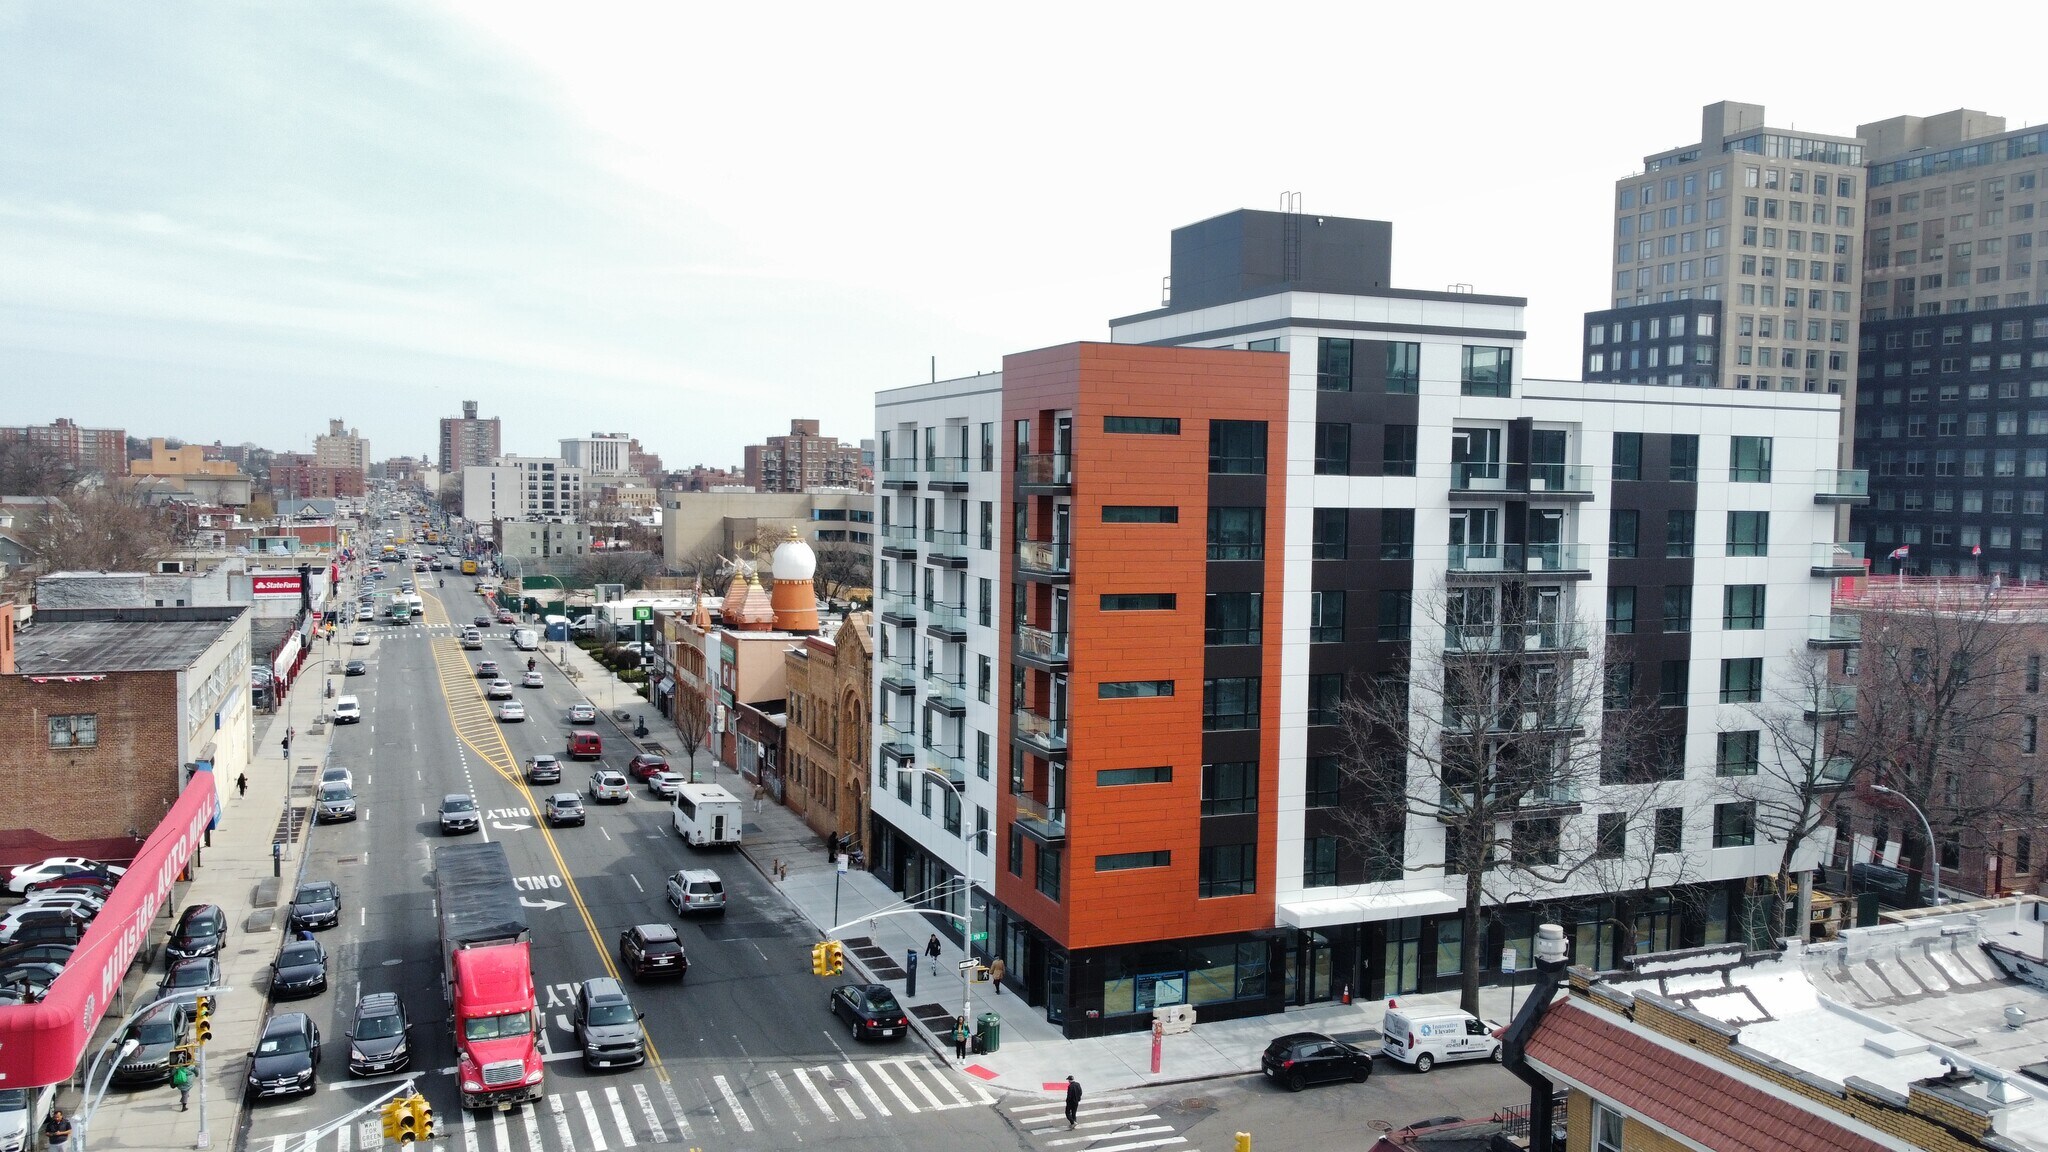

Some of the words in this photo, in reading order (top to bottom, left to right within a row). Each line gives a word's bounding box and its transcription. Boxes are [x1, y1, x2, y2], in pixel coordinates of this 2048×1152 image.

[637, 609, 649, 618] TD
[486, 807, 531, 820] ONLY
[102, 891, 154, 1005] Hillside
[157, 834, 187, 903] AUTO
[190, 793, 212, 845] MALL
[1812, 909, 1825, 920] CAT
[362, 1133, 381, 1142] GREEN
[363, 1139, 380, 1147] LIGHT
